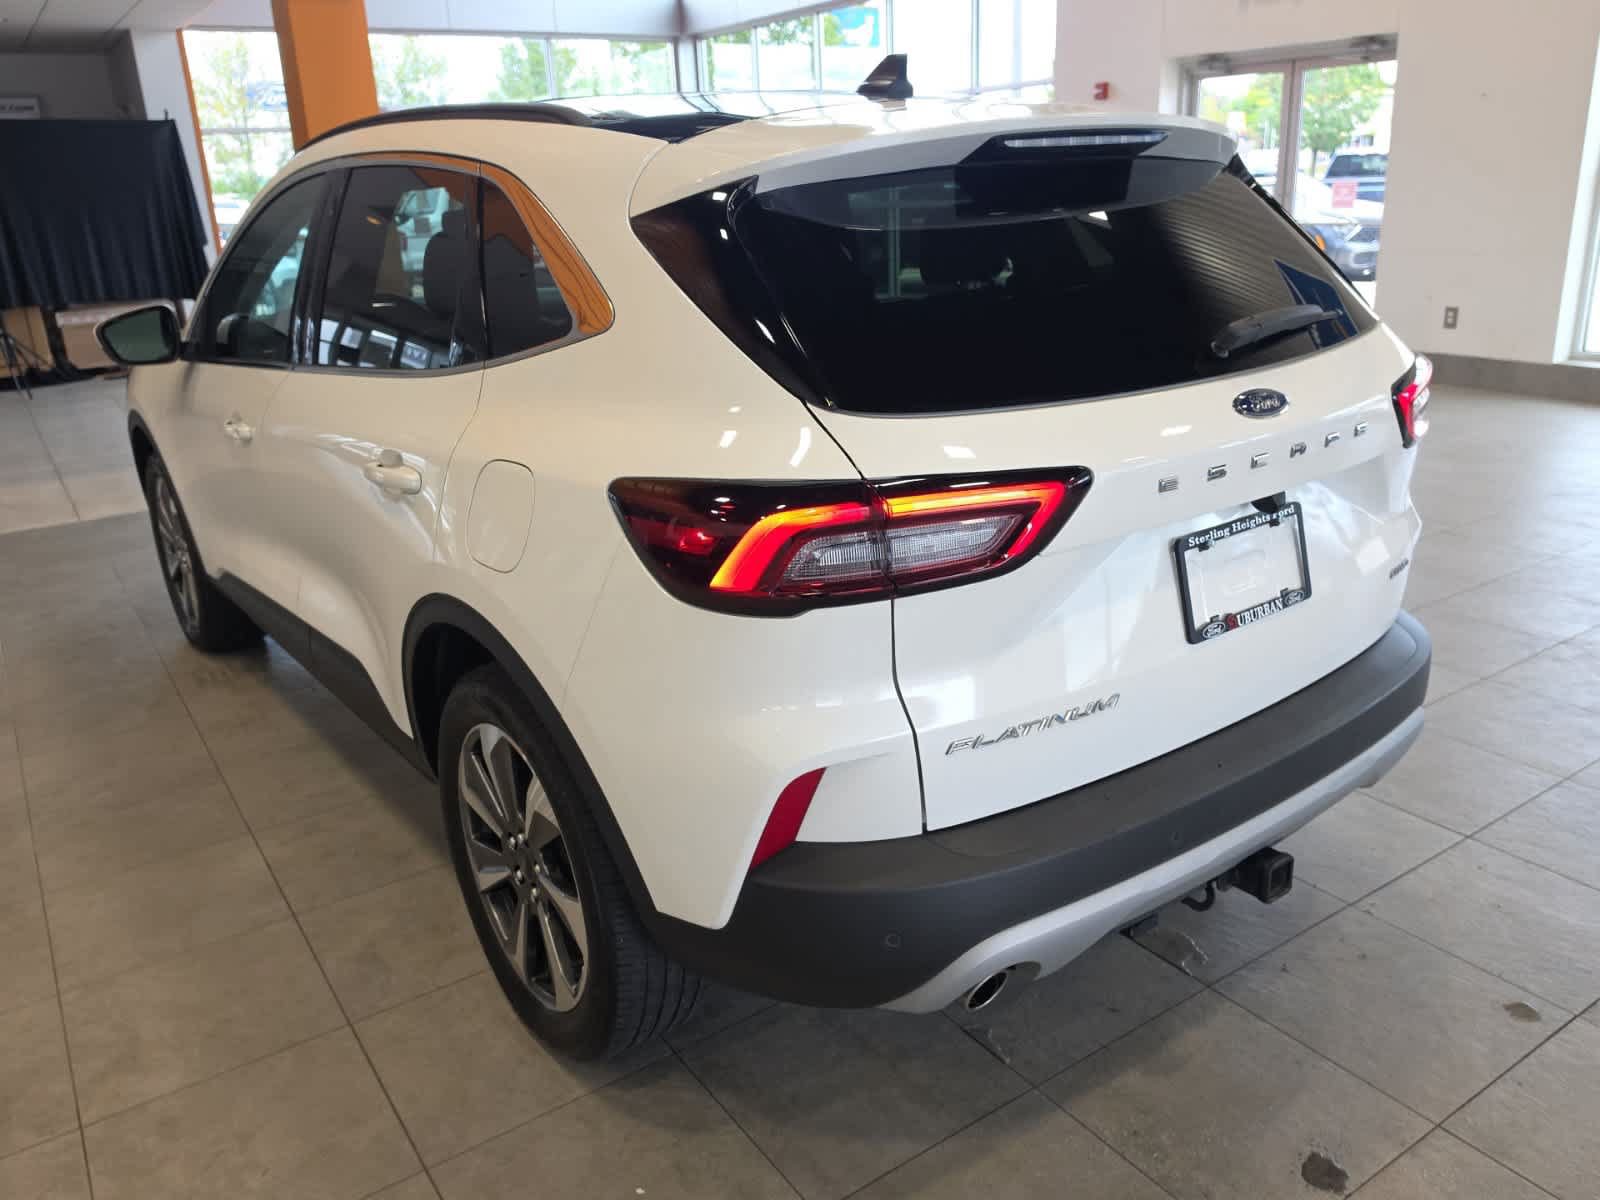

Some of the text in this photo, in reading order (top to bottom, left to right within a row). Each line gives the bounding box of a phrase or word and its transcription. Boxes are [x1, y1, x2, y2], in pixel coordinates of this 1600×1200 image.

[1188, 527, 1231, 547] Sterling
[1231, 513, 1271, 533] Heights
[1226, 598, 1284, 629] SUBURBAN
[945, 693, 1120, 755] PLATINUM
